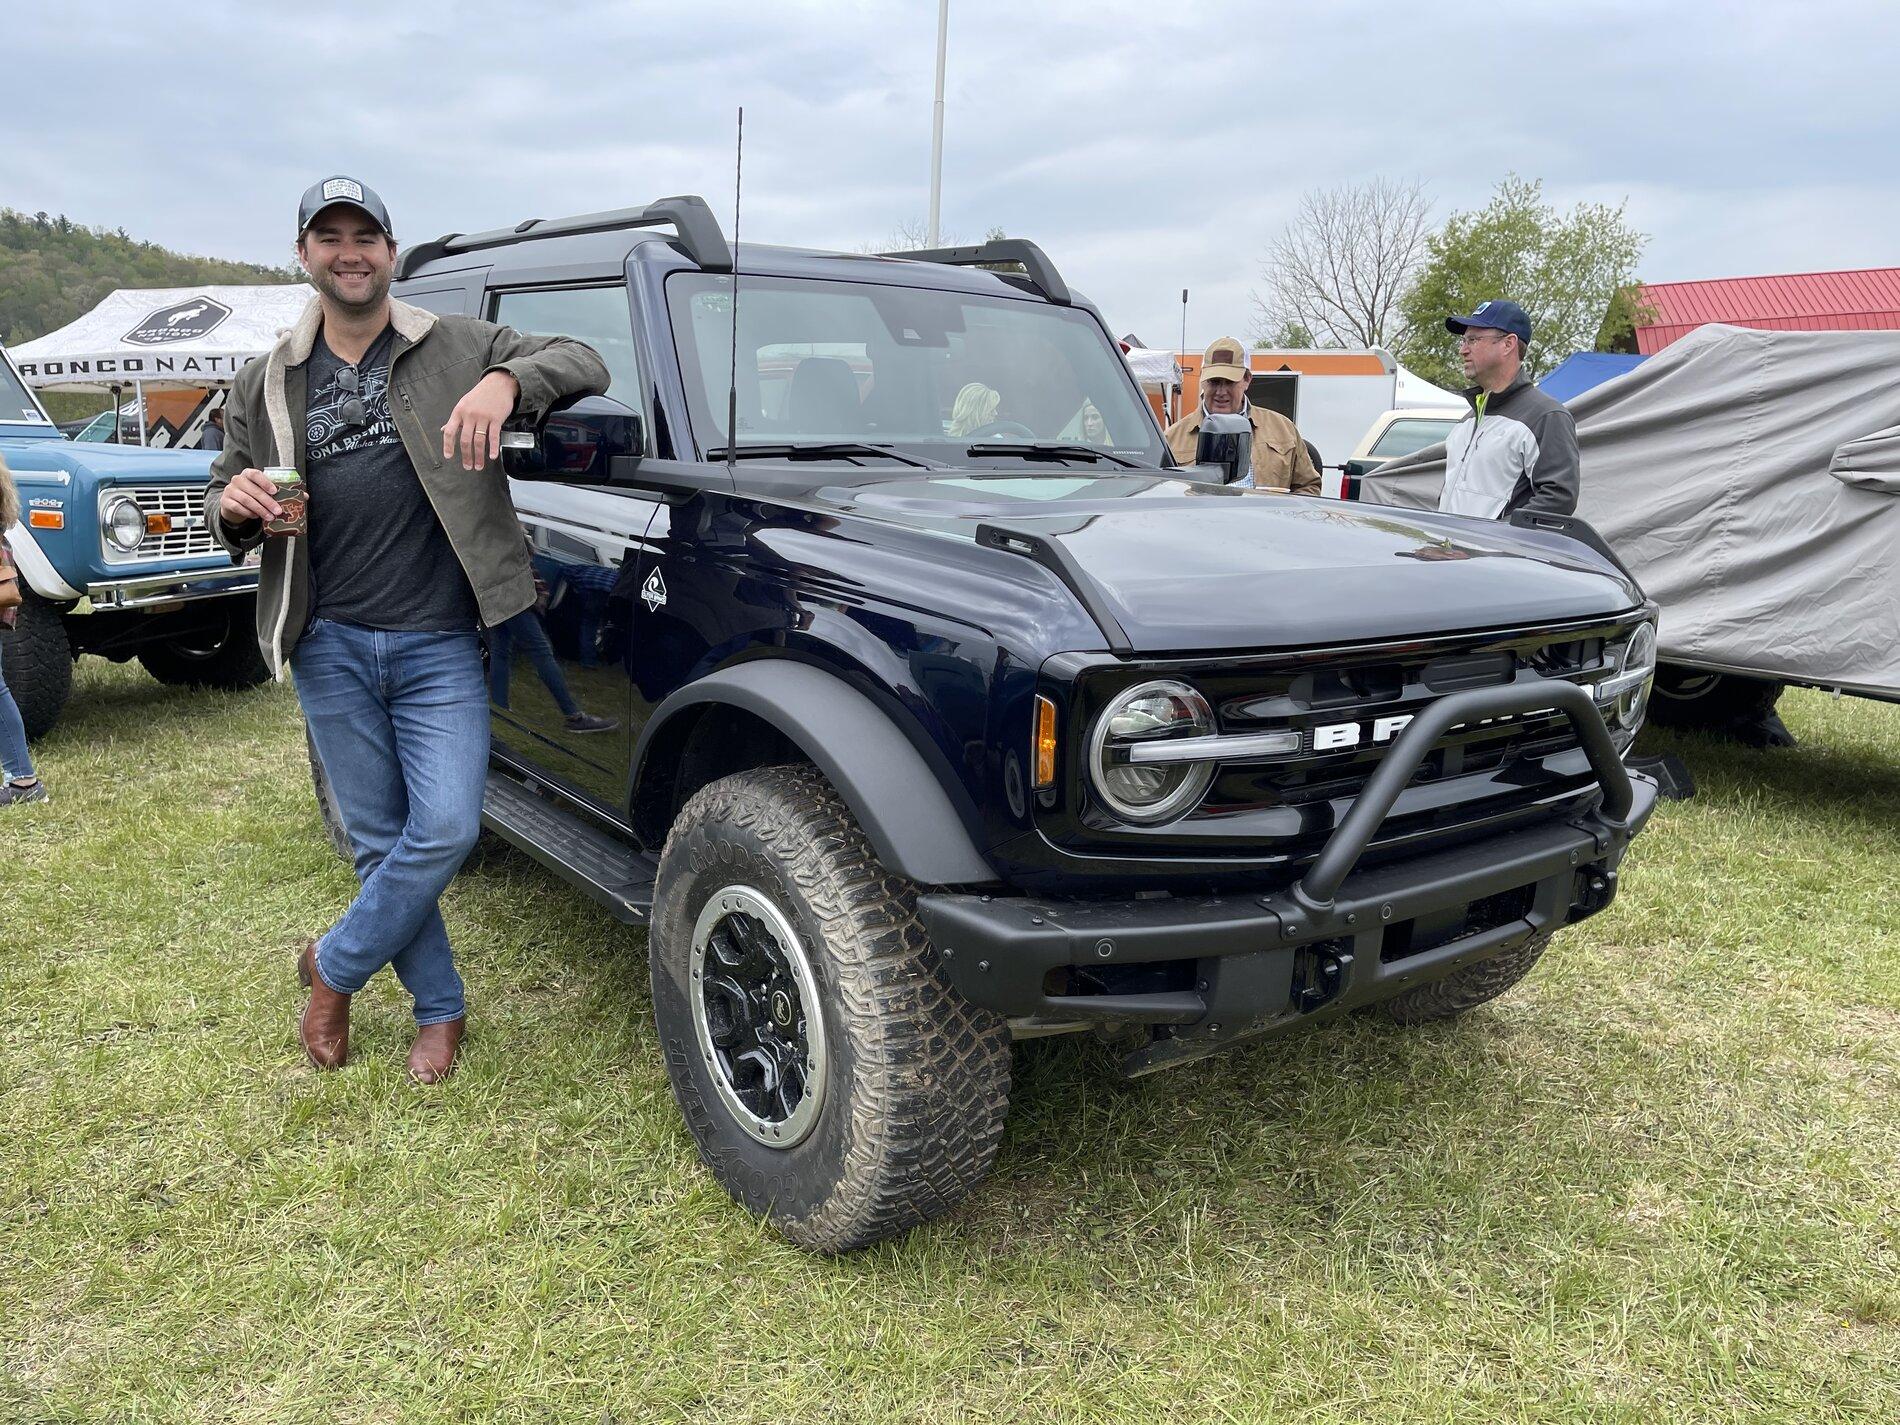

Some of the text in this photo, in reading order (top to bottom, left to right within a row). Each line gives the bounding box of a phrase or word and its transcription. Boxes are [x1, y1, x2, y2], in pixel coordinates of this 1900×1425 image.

[18, 356, 256, 376] RONCO NATI
[343, 420, 397, 447] BRWIN
